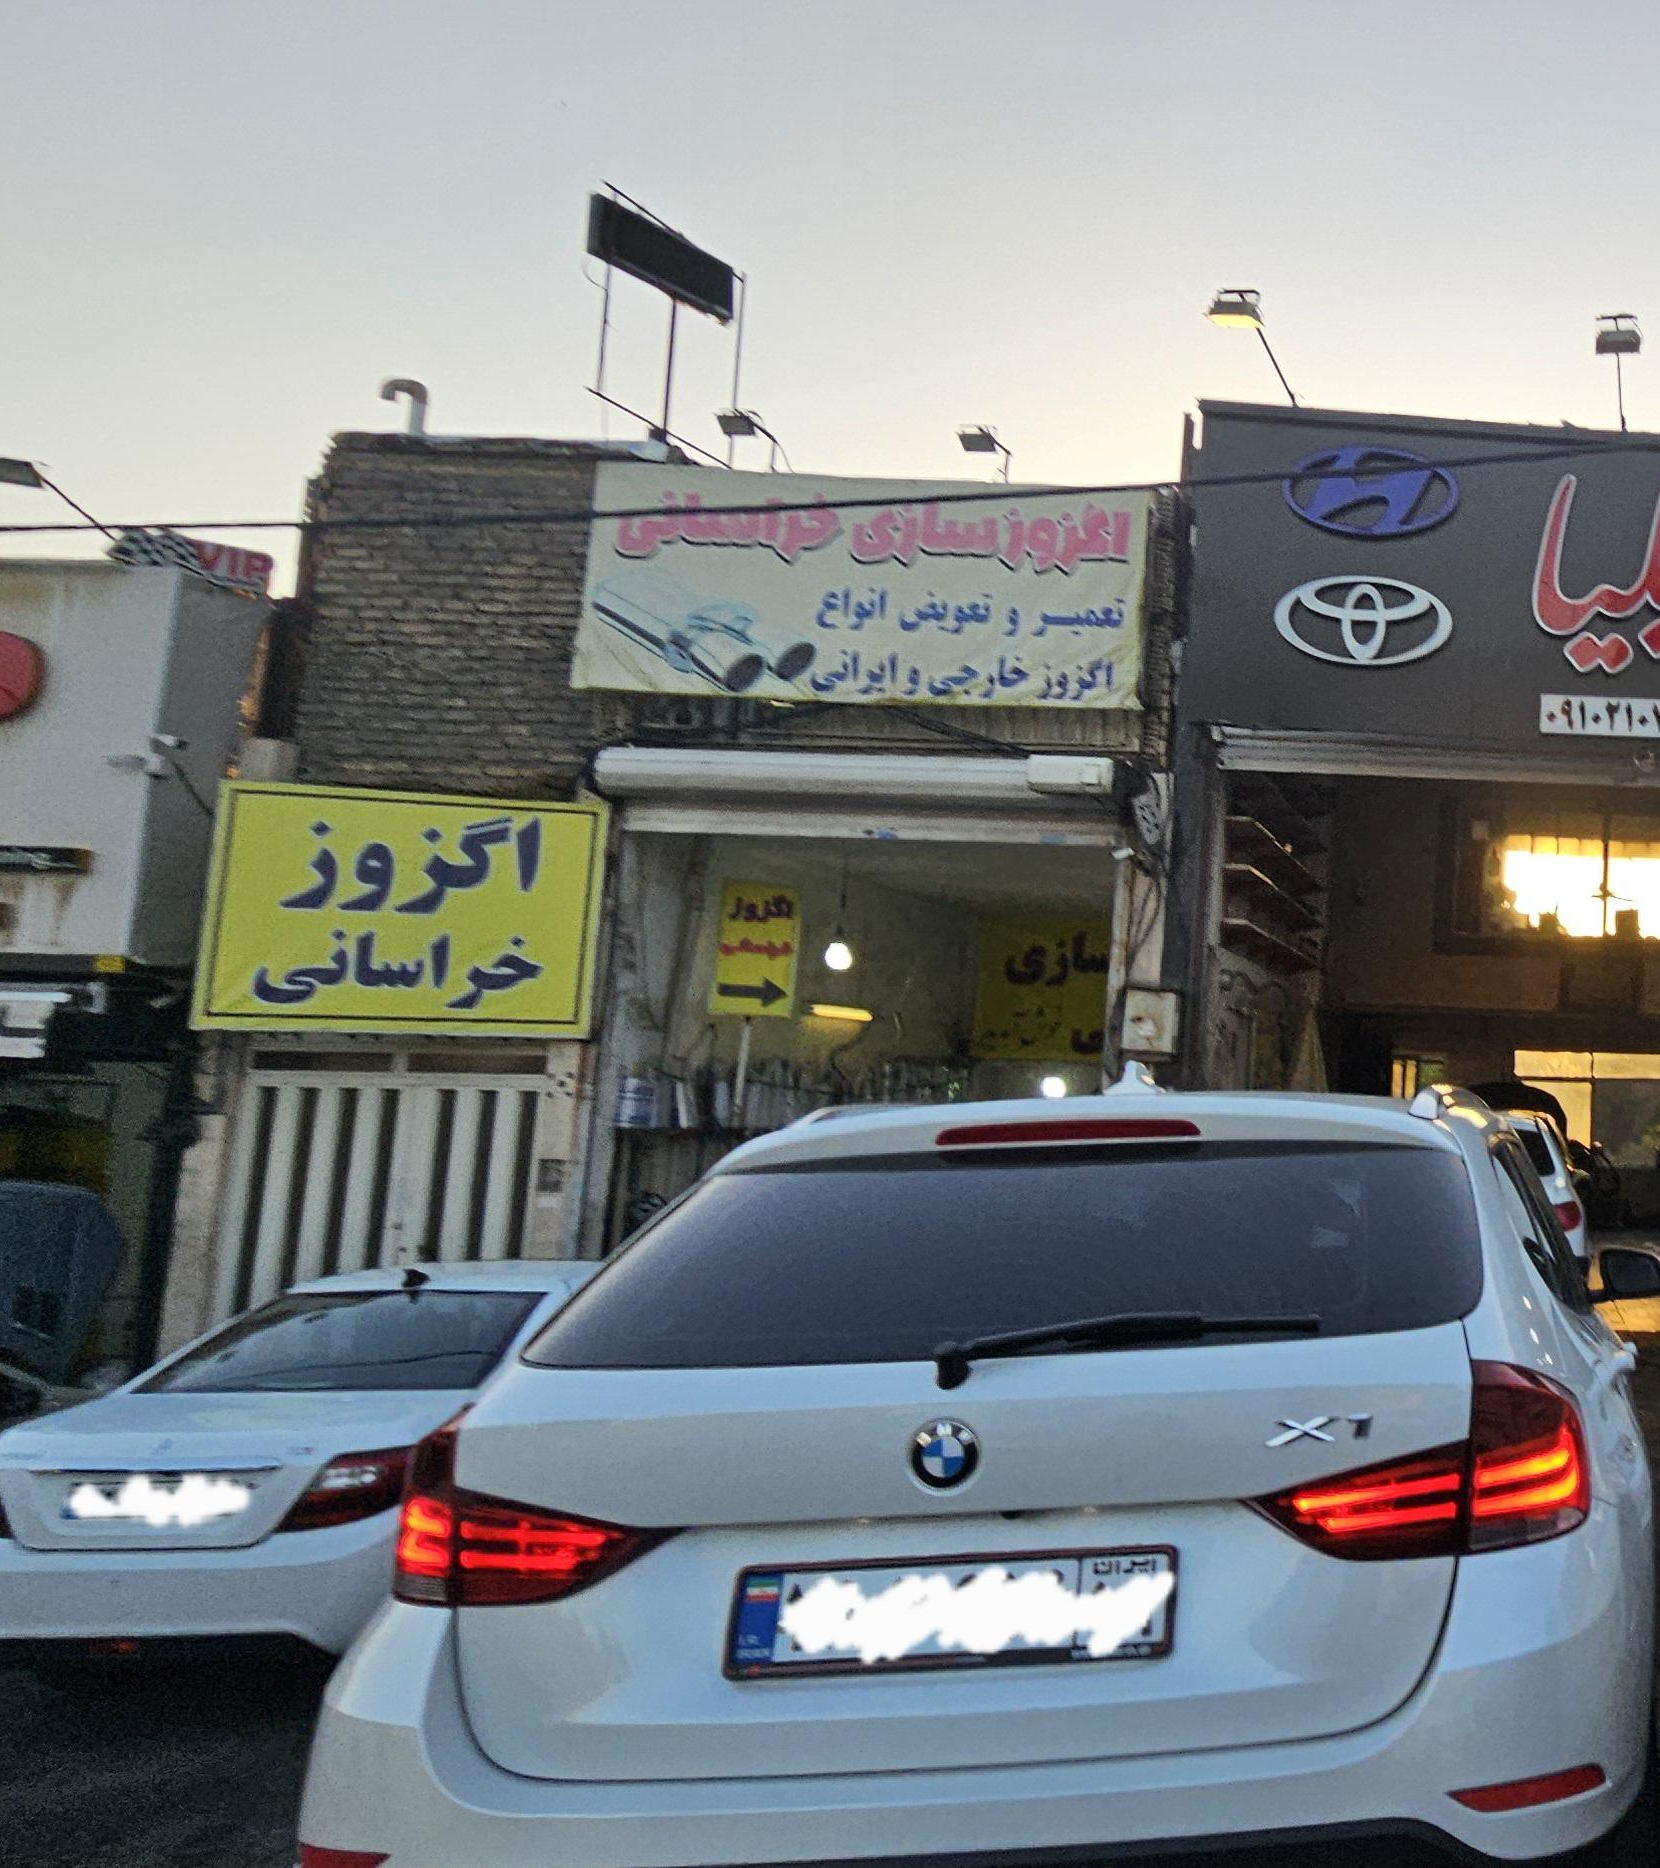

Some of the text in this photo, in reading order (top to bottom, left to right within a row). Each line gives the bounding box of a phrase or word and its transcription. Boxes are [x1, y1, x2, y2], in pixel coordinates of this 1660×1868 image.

[613, 490, 844, 566] خراسانی
[194, 540, 275, 579] VIP
[815, 586, 1126, 637] تعمیر و تعویض انواع
[809, 649, 1116, 700] اگزوز خارجی و ایرانی
[279, 816, 541, 915] اگزوز
[252, 928, 545, 1010] خراسانی
[1263, 1412, 1373, 1447] X1
[1094, 1558, 1156, 1575] ایران
